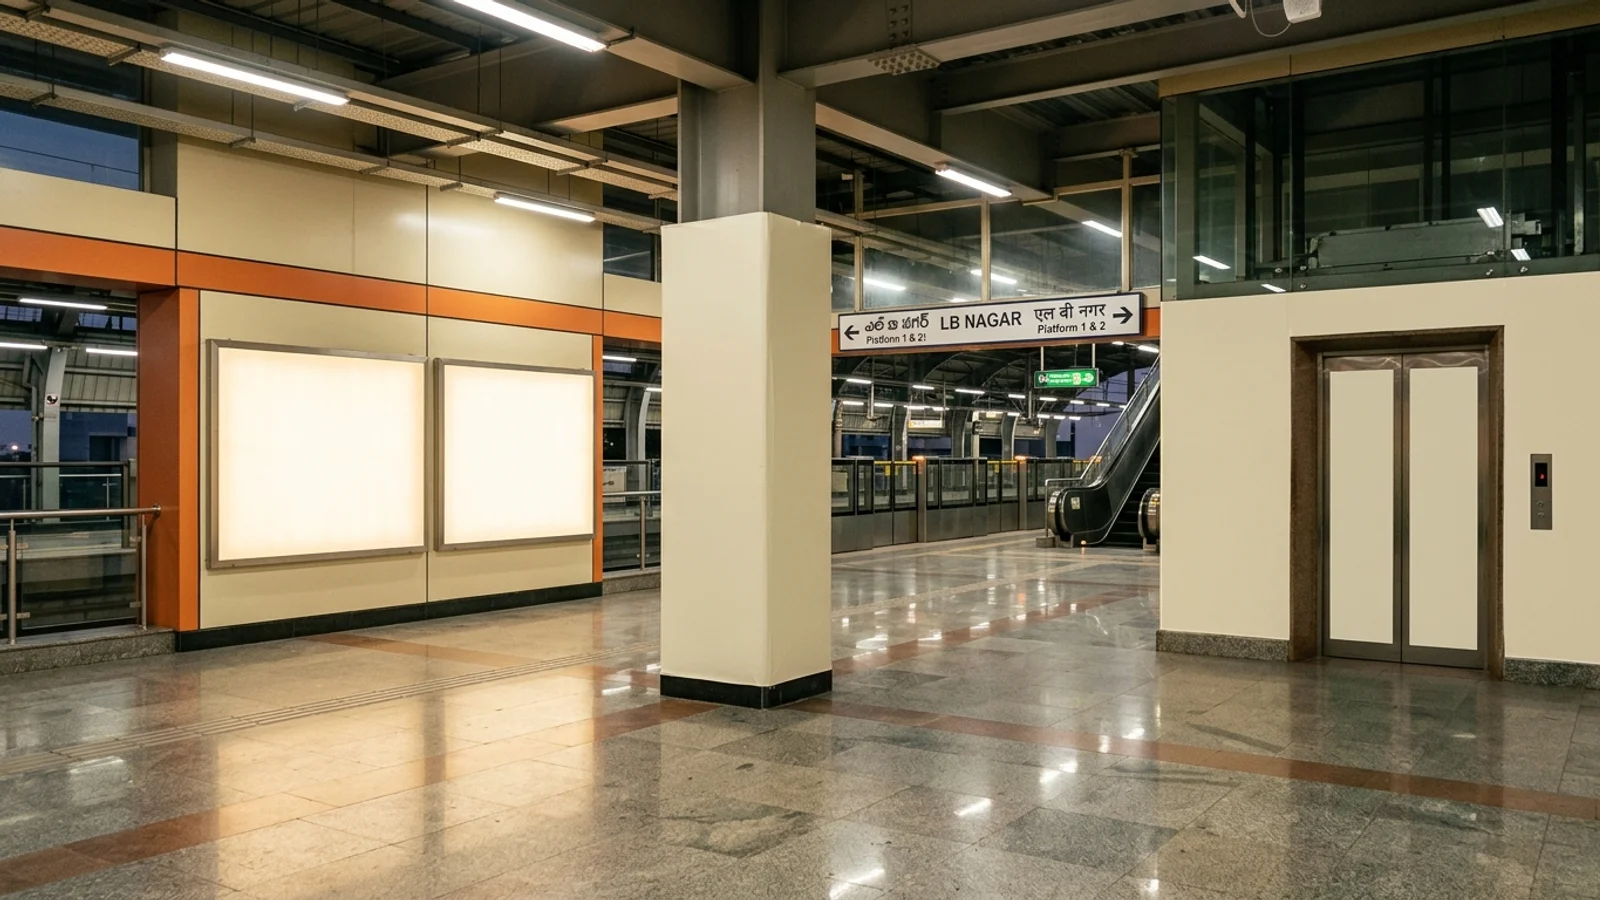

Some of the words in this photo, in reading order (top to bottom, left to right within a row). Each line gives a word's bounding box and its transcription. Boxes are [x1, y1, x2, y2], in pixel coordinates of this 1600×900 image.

[1034, 308, 1056, 322] एल
[1078, 304, 1106, 317] नगर
[941, 316, 960, 330] LB
[965, 312, 1022, 329] NAGAR
[1081, 322, 1086, 331] 1
[1089, 321, 1097, 331] &
[1100, 321, 1106, 331] 2
[902, 334, 907, 342] 1
[910, 333, 916, 342] &
